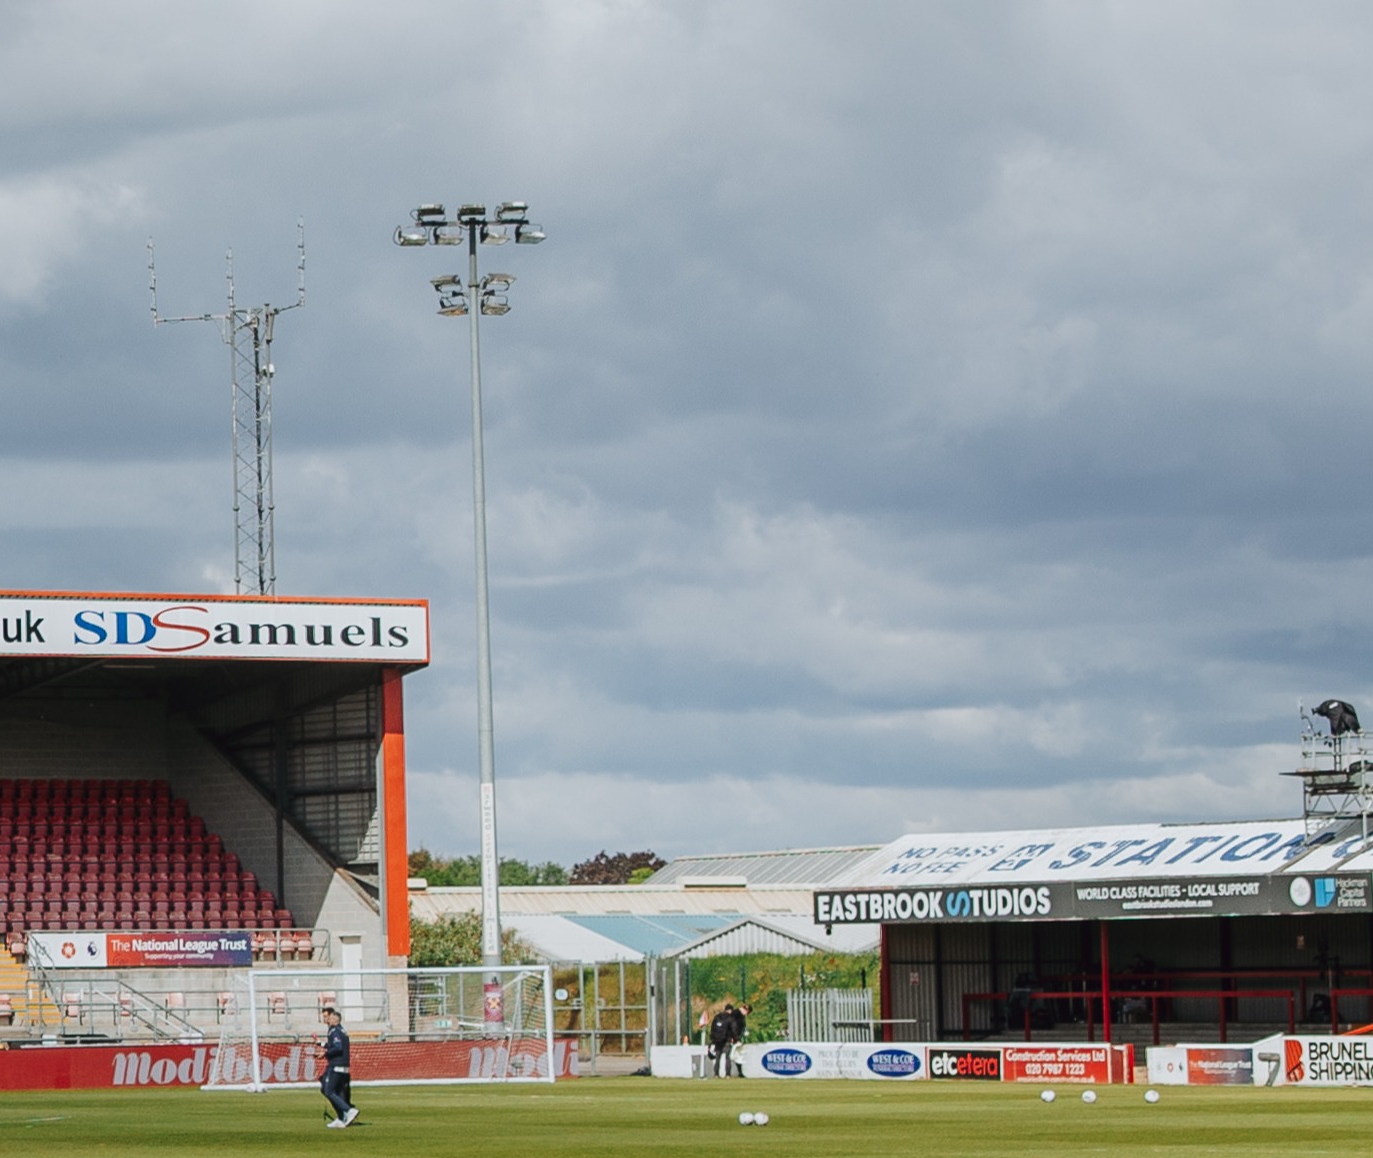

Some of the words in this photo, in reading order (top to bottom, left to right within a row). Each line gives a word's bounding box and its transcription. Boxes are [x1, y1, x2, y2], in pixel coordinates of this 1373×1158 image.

[898, 847, 937, 859] NO
[882, 862, 919, 875] NO
[1076, 887, 1109, 901] WORLD
[1110, 886, 1137, 900] CLASS
[1138, 884, 1181, 899] FACILITIES
[1188, 883, 1218, 897] LOCAL
[1218, 882, 1260, 896] SUPPORT
[817, 891, 944, 922] EASTBROOK
[110, 938, 131, 952] The
[132, 938, 181, 952] National
[182, 938, 218, 953] League
[219, 937, 247, 951] Trust
[1005, 1049, 1056, 1062] Construction
[1056, 1049, 1091, 1062] Services
[1091, 1049, 1106, 1062] Ltd
[1309, 1042, 1373, 1061] BRUNEL
[931, 1051, 999, 1076] etcetera
[1025, 1063, 1041, 1075] 020
